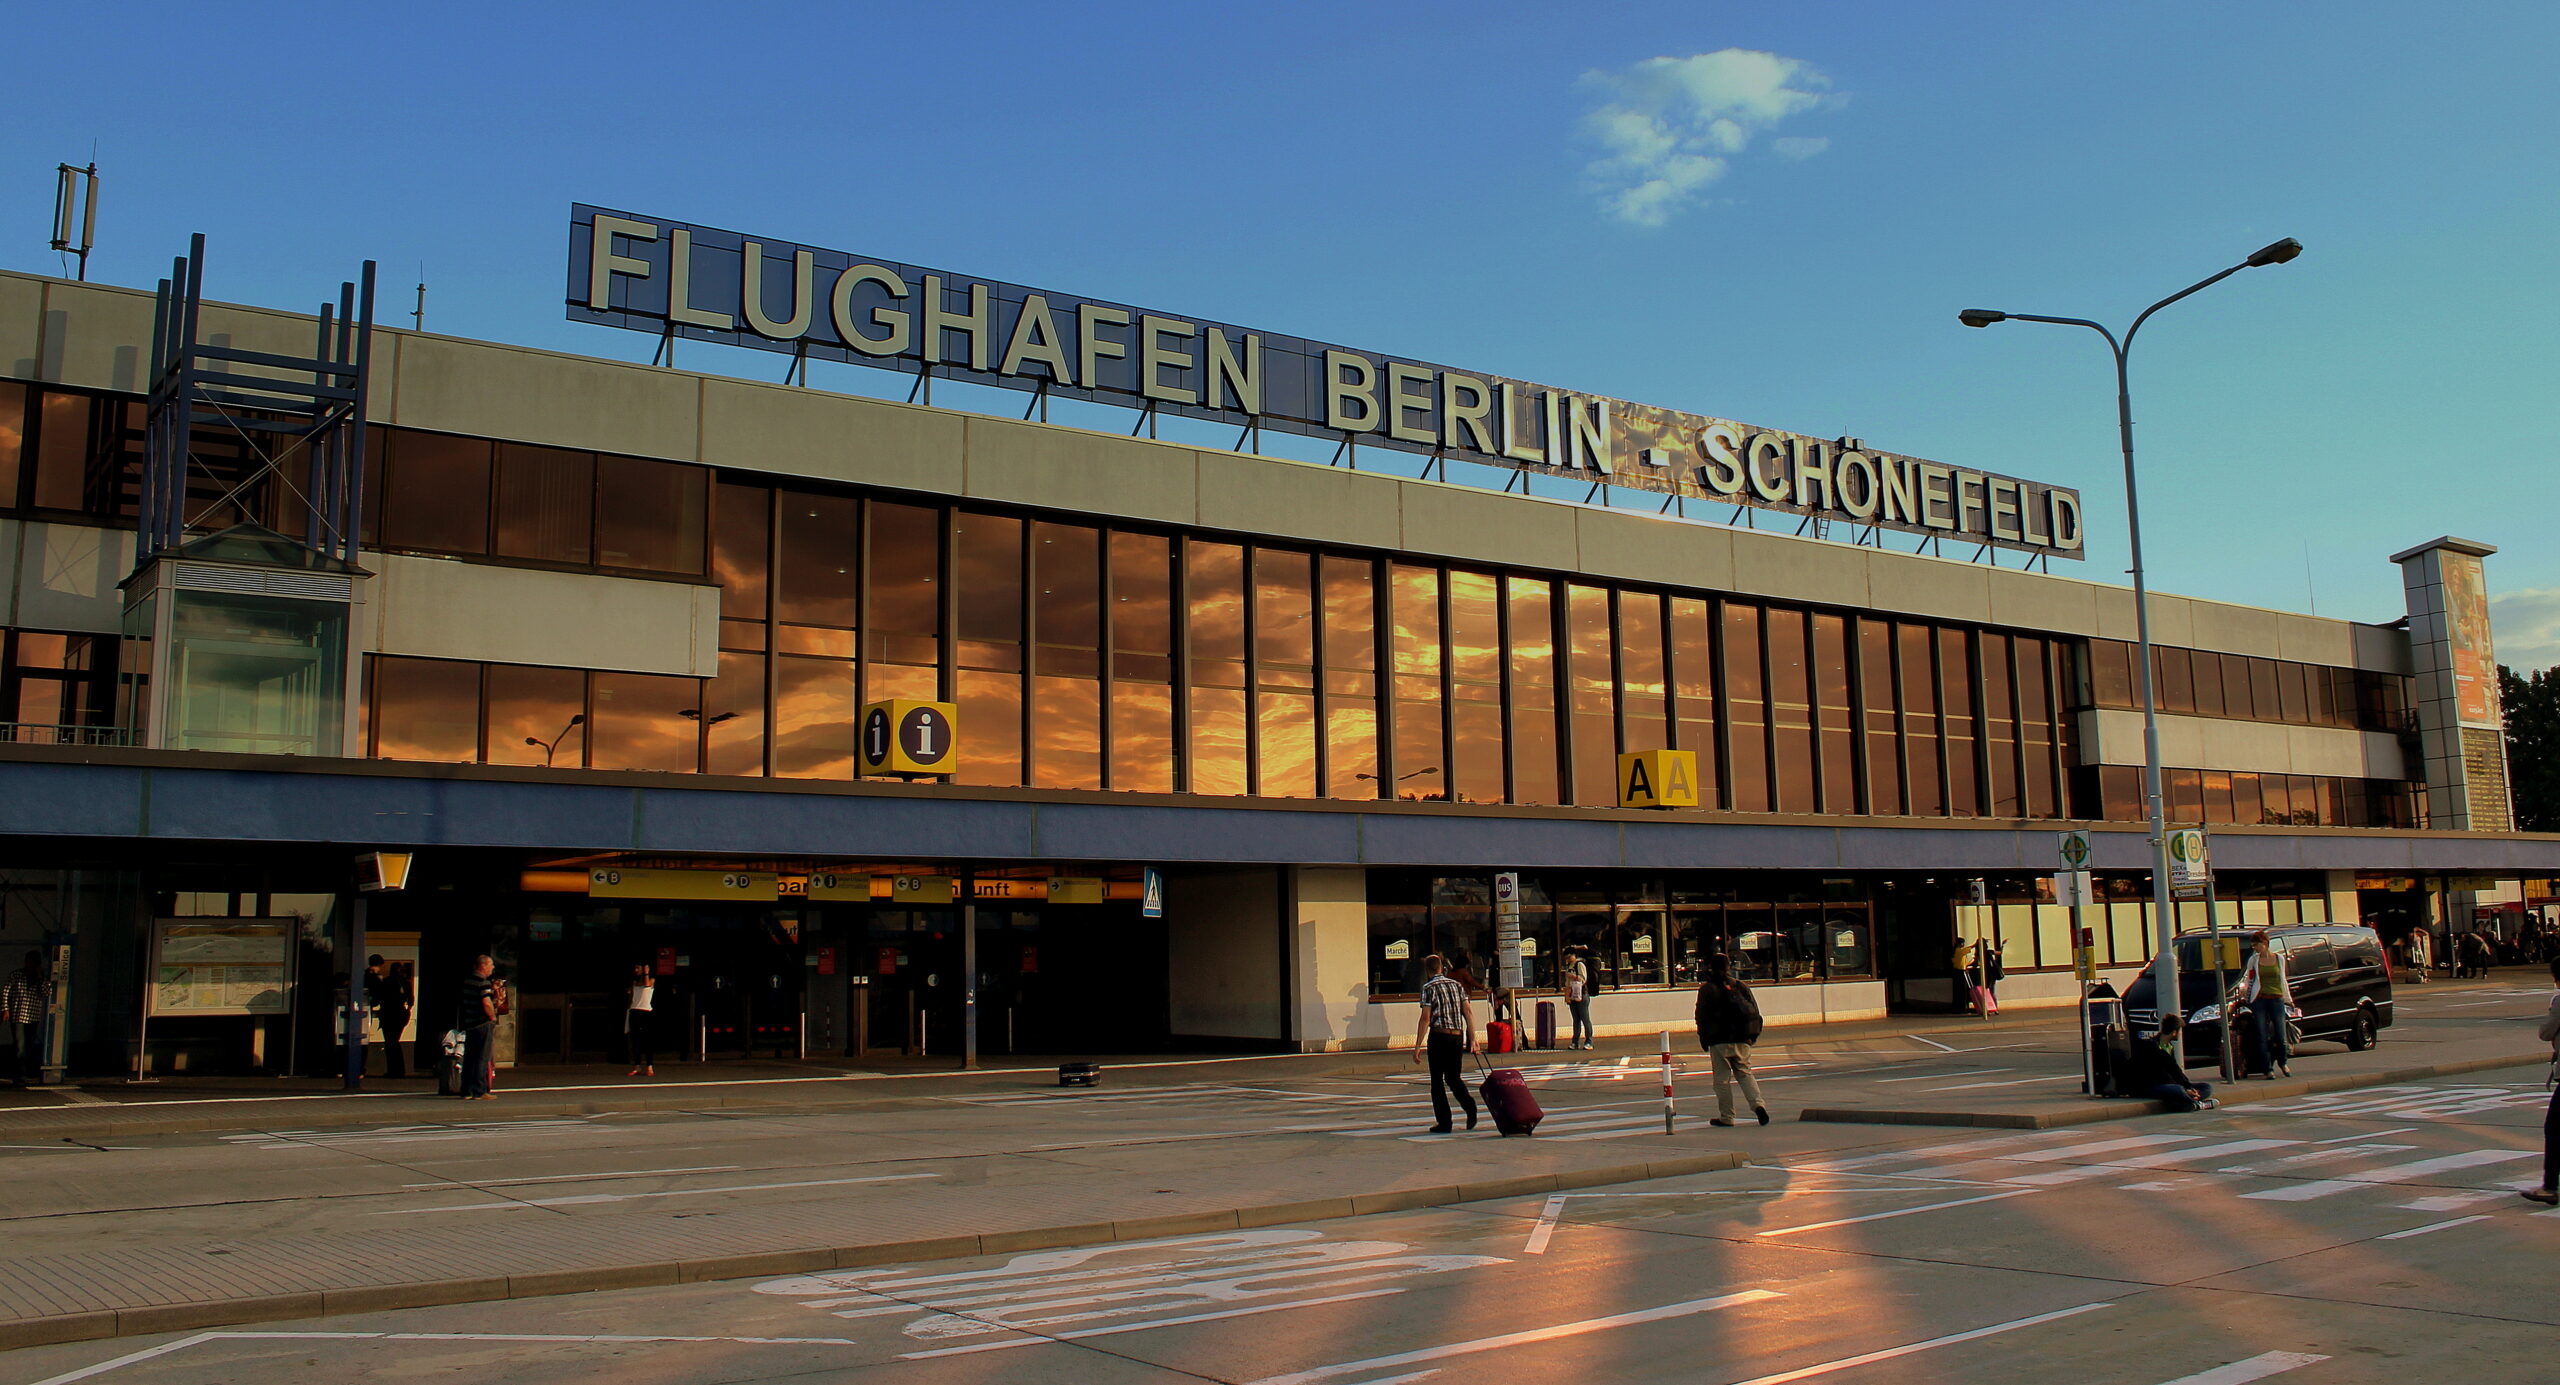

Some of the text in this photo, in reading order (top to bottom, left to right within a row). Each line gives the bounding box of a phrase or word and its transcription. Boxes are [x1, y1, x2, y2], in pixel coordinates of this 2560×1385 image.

[590, 213, 2082, 550] FLUGHAFEN BERLIN - SCHÖNEFELD
[1626, 758, 1654, 802] A
[1665, 756, 1692, 799] A
[1498, 883, 1512, 893] BUS
[61, 949, 70, 980] Service
[1387, 946, 1407, 954] Marché
